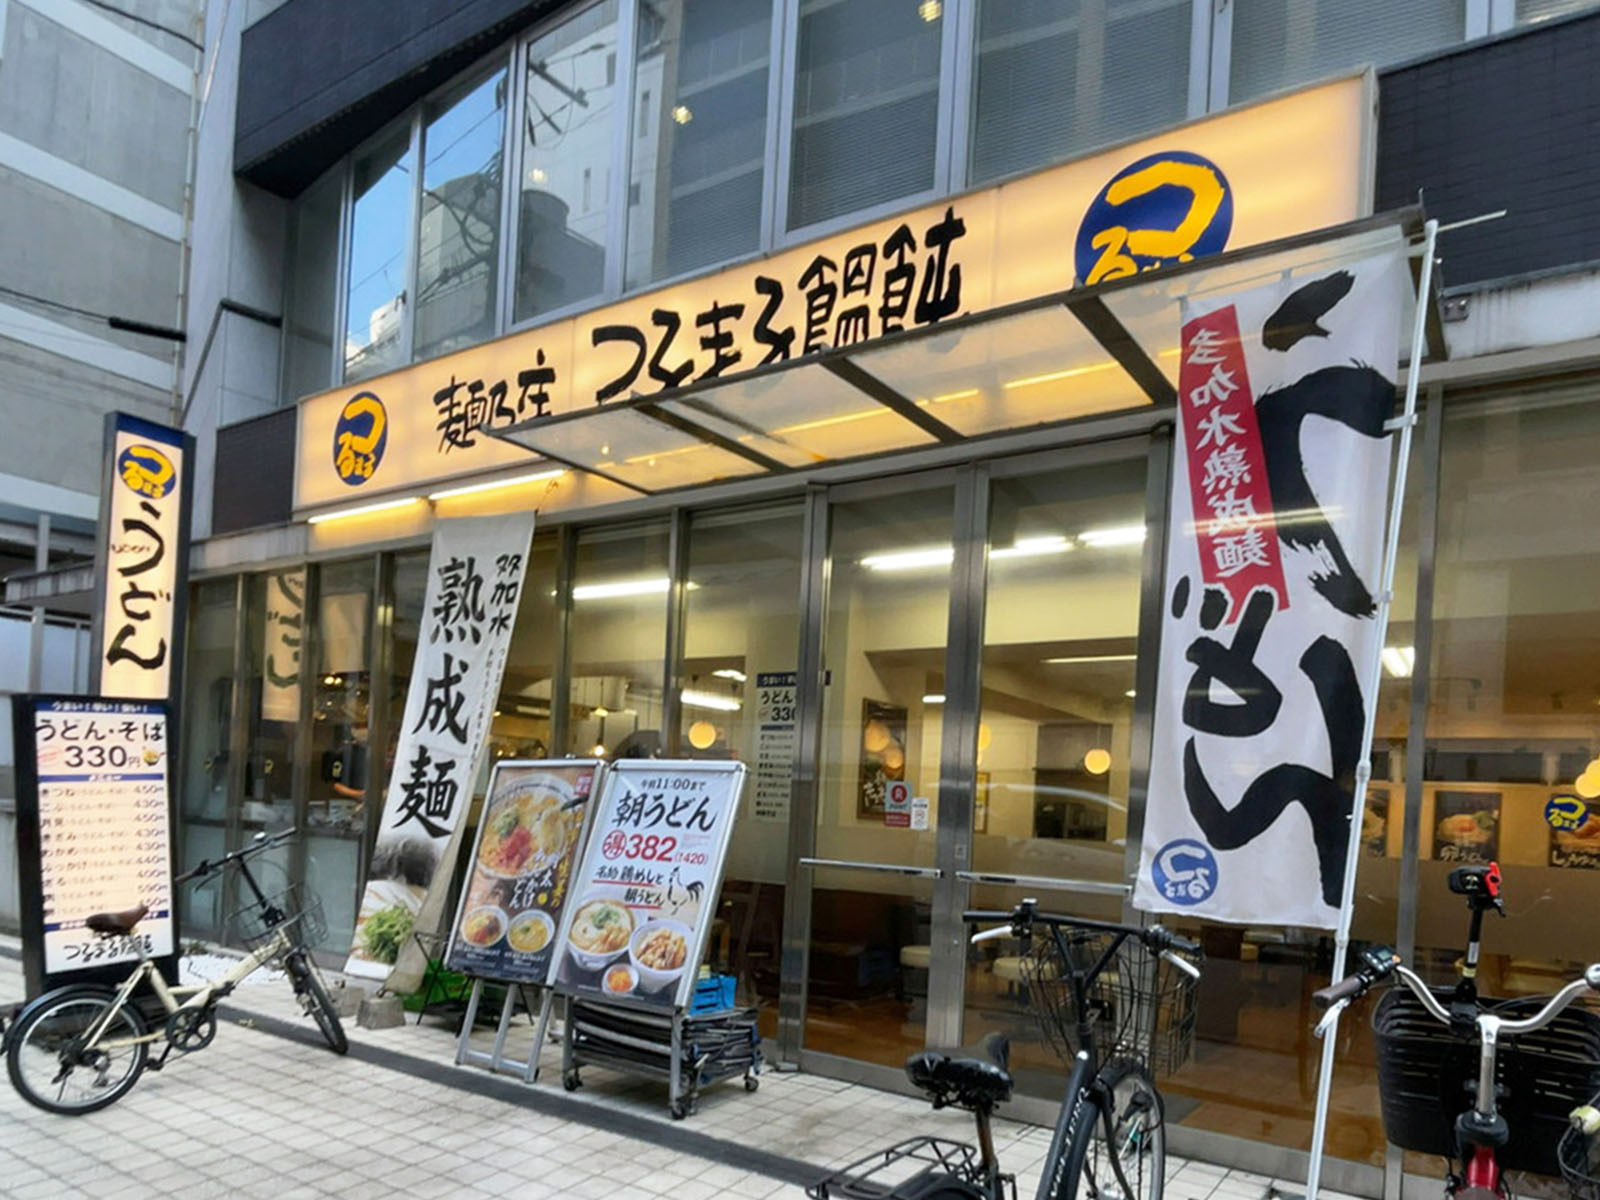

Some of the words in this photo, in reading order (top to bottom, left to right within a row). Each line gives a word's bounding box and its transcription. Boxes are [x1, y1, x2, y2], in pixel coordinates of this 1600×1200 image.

[106, 501, 170, 670] うどん
[392, 556, 486, 838] 熟成麺
[36, 719, 164, 741] うどん・そば
[612, 790, 718, 832] 朝うどん
[625, 834, 677, 862] 382
